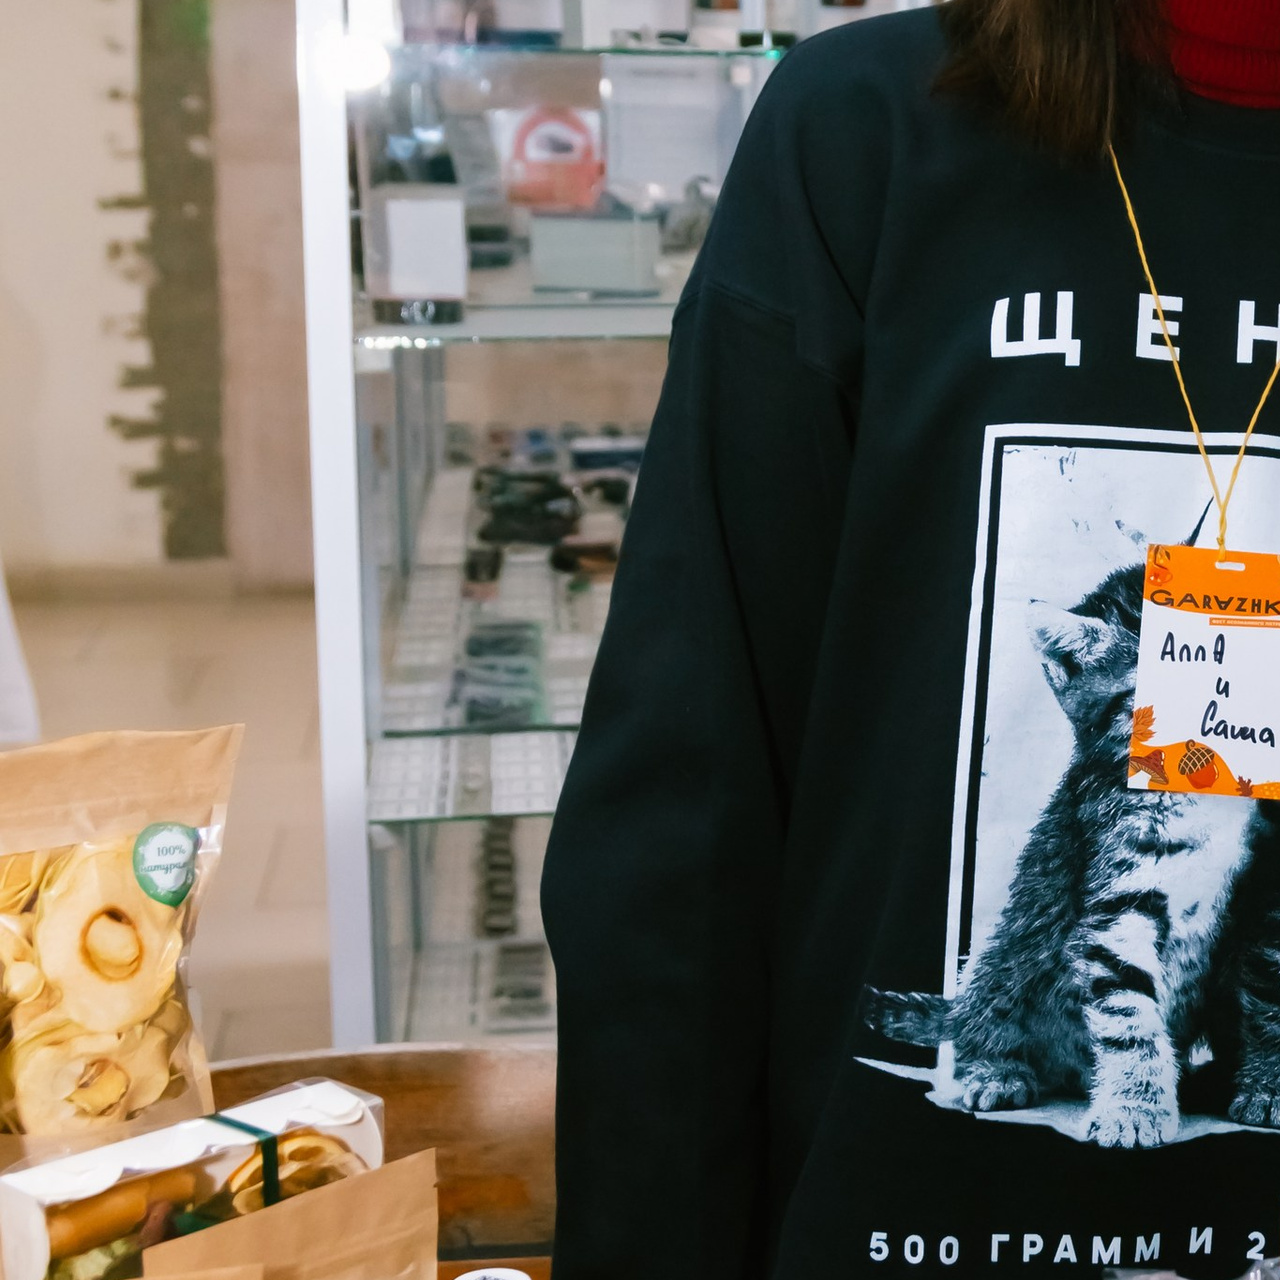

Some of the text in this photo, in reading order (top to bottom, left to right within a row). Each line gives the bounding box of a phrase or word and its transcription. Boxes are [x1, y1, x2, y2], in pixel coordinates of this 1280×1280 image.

[157, 844, 187, 857] 100%
[869, 1231, 960, 1266] 500
[990, 1232, 1161, 1265] ГРАММ
[1189, 1226, 1214, 1254] И
[1246, 1230, 1266, 1261] 2
